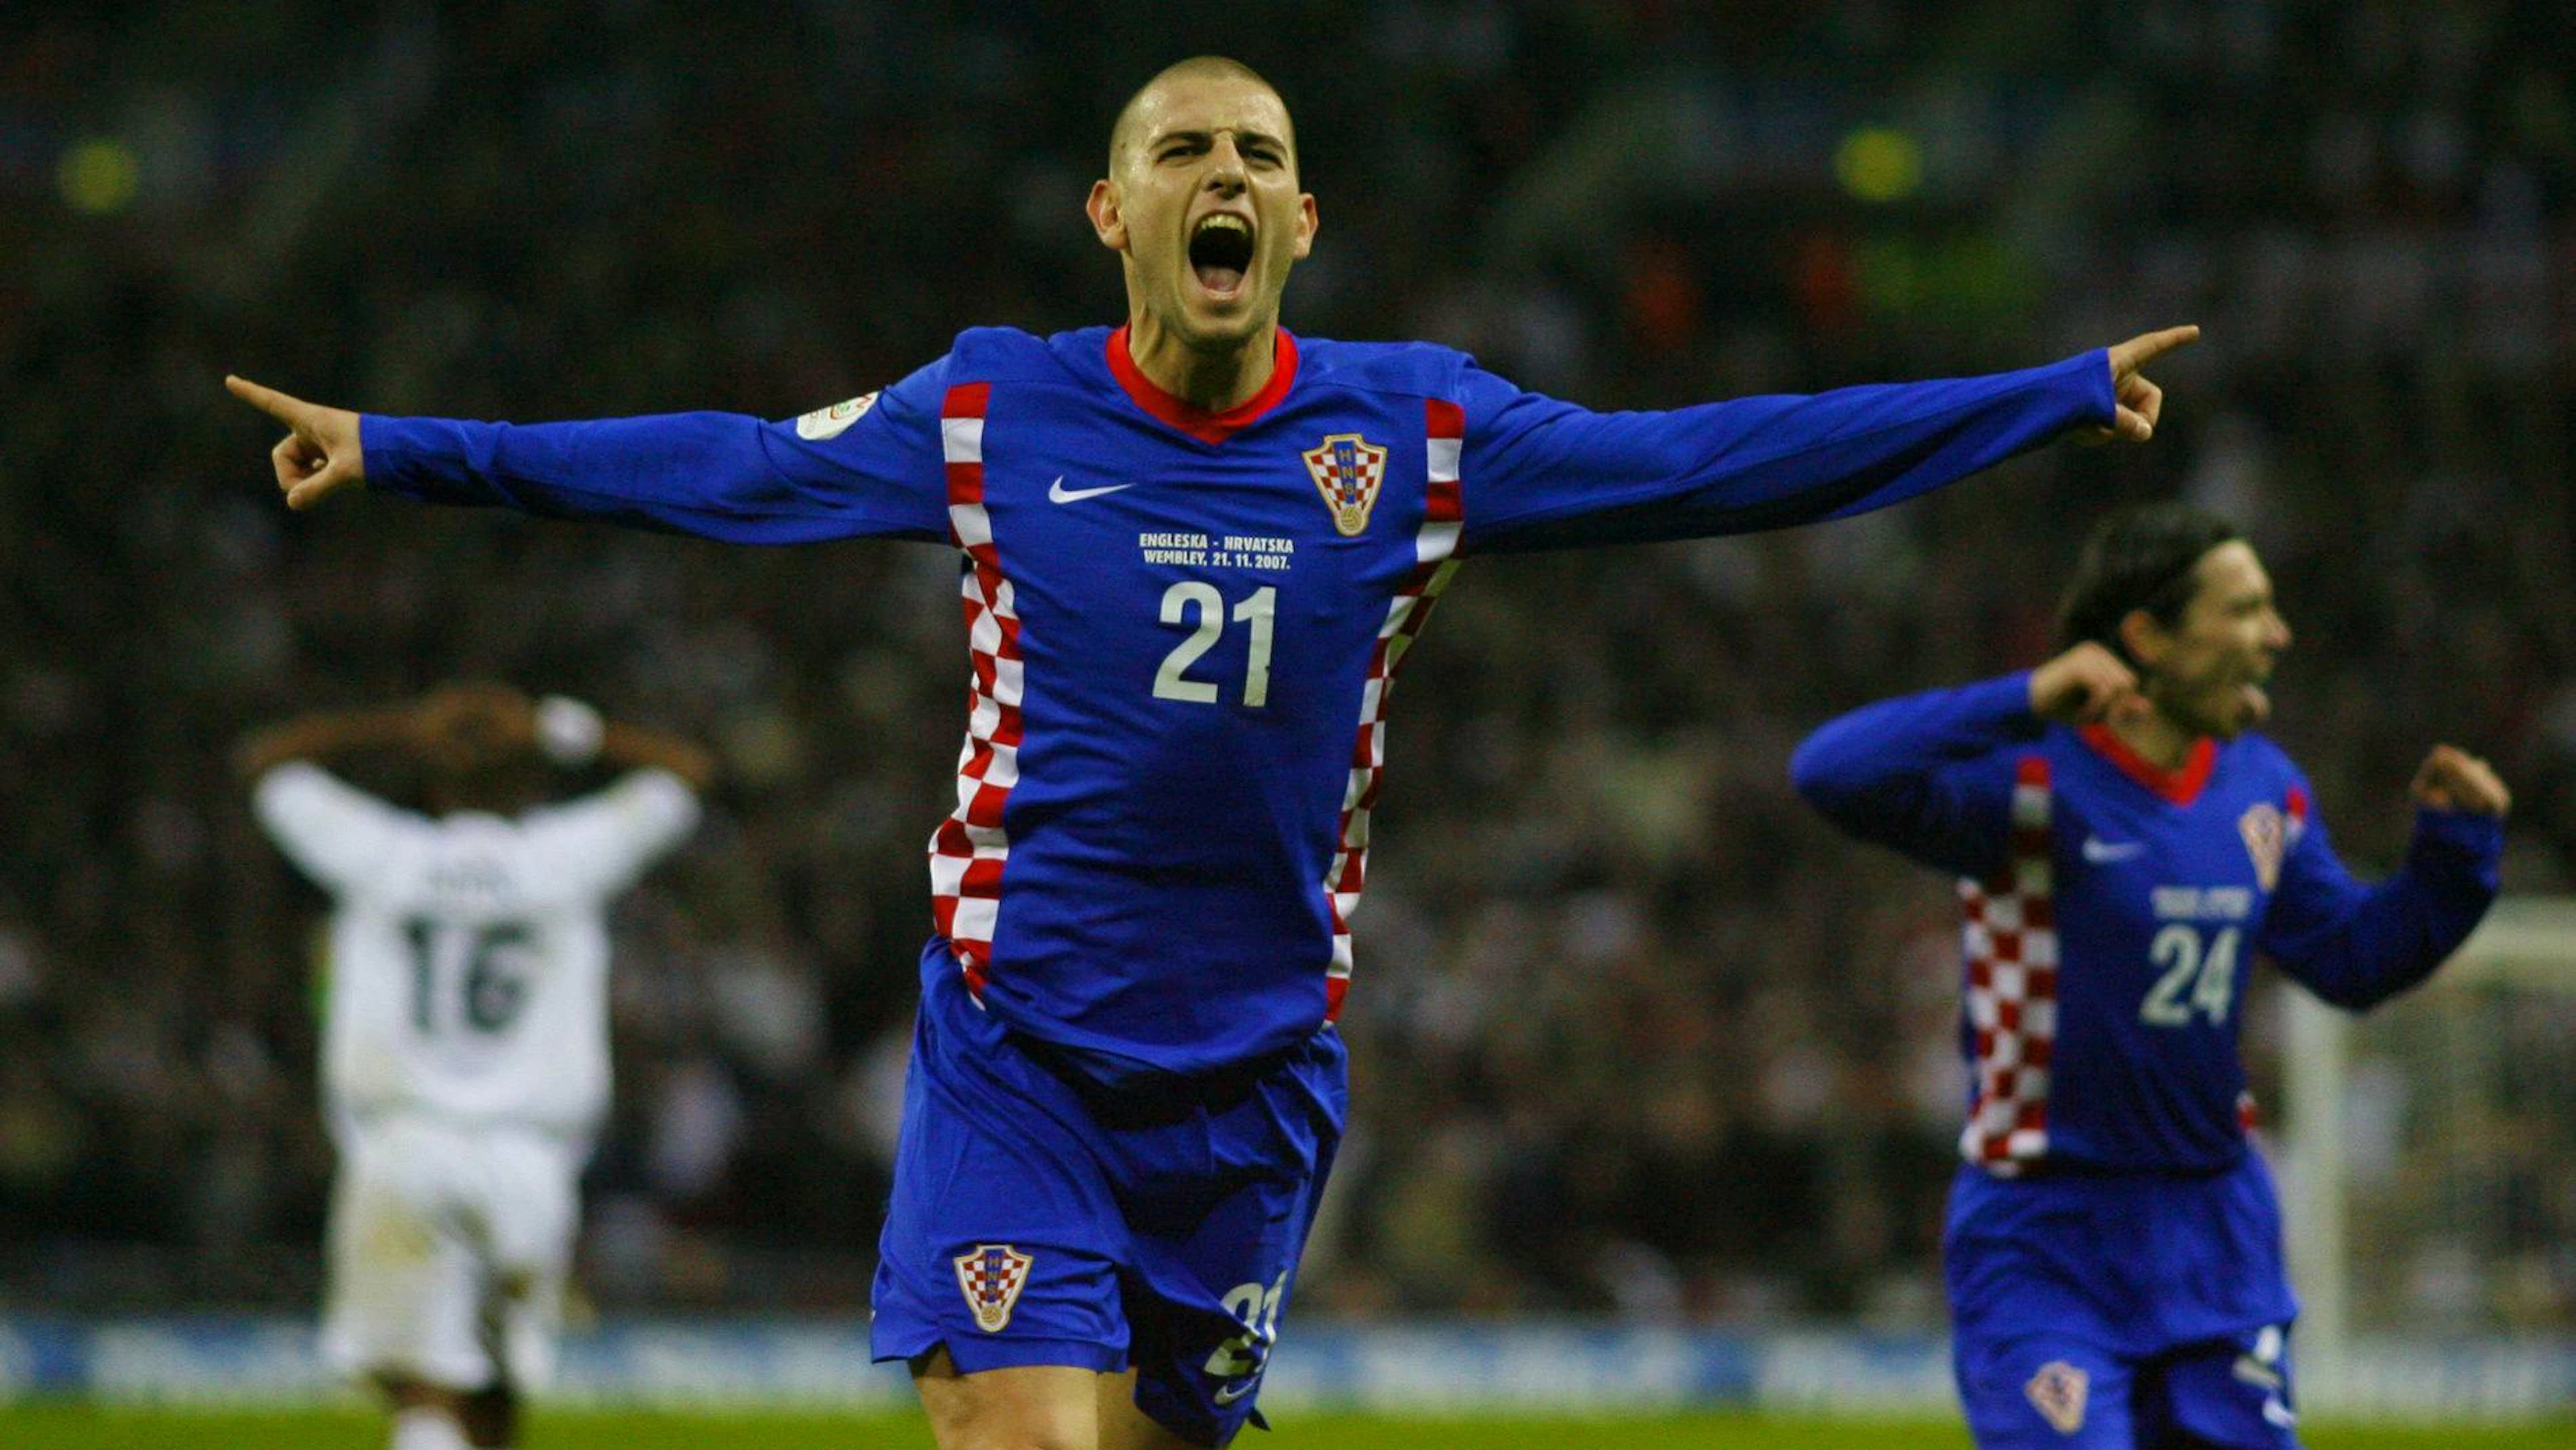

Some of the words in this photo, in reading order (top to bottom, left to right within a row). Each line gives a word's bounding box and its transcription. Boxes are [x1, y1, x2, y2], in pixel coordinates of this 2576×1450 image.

[1139, 533, 1208, 549] ENGLESKA
[1224, 536, 1294, 553] HRVATSKA
[1144, 550, 1208, 566] WEMBLEY,
[1212, 552, 1232, 566] 21.
[1236, 554, 1252, 568] 11.
[1255, 554, 1291, 569] 2007.
[1152, 580, 1277, 707] 21
[401, 911, 537, 1037] 16
[2139, 923, 2241, 1027] 24
